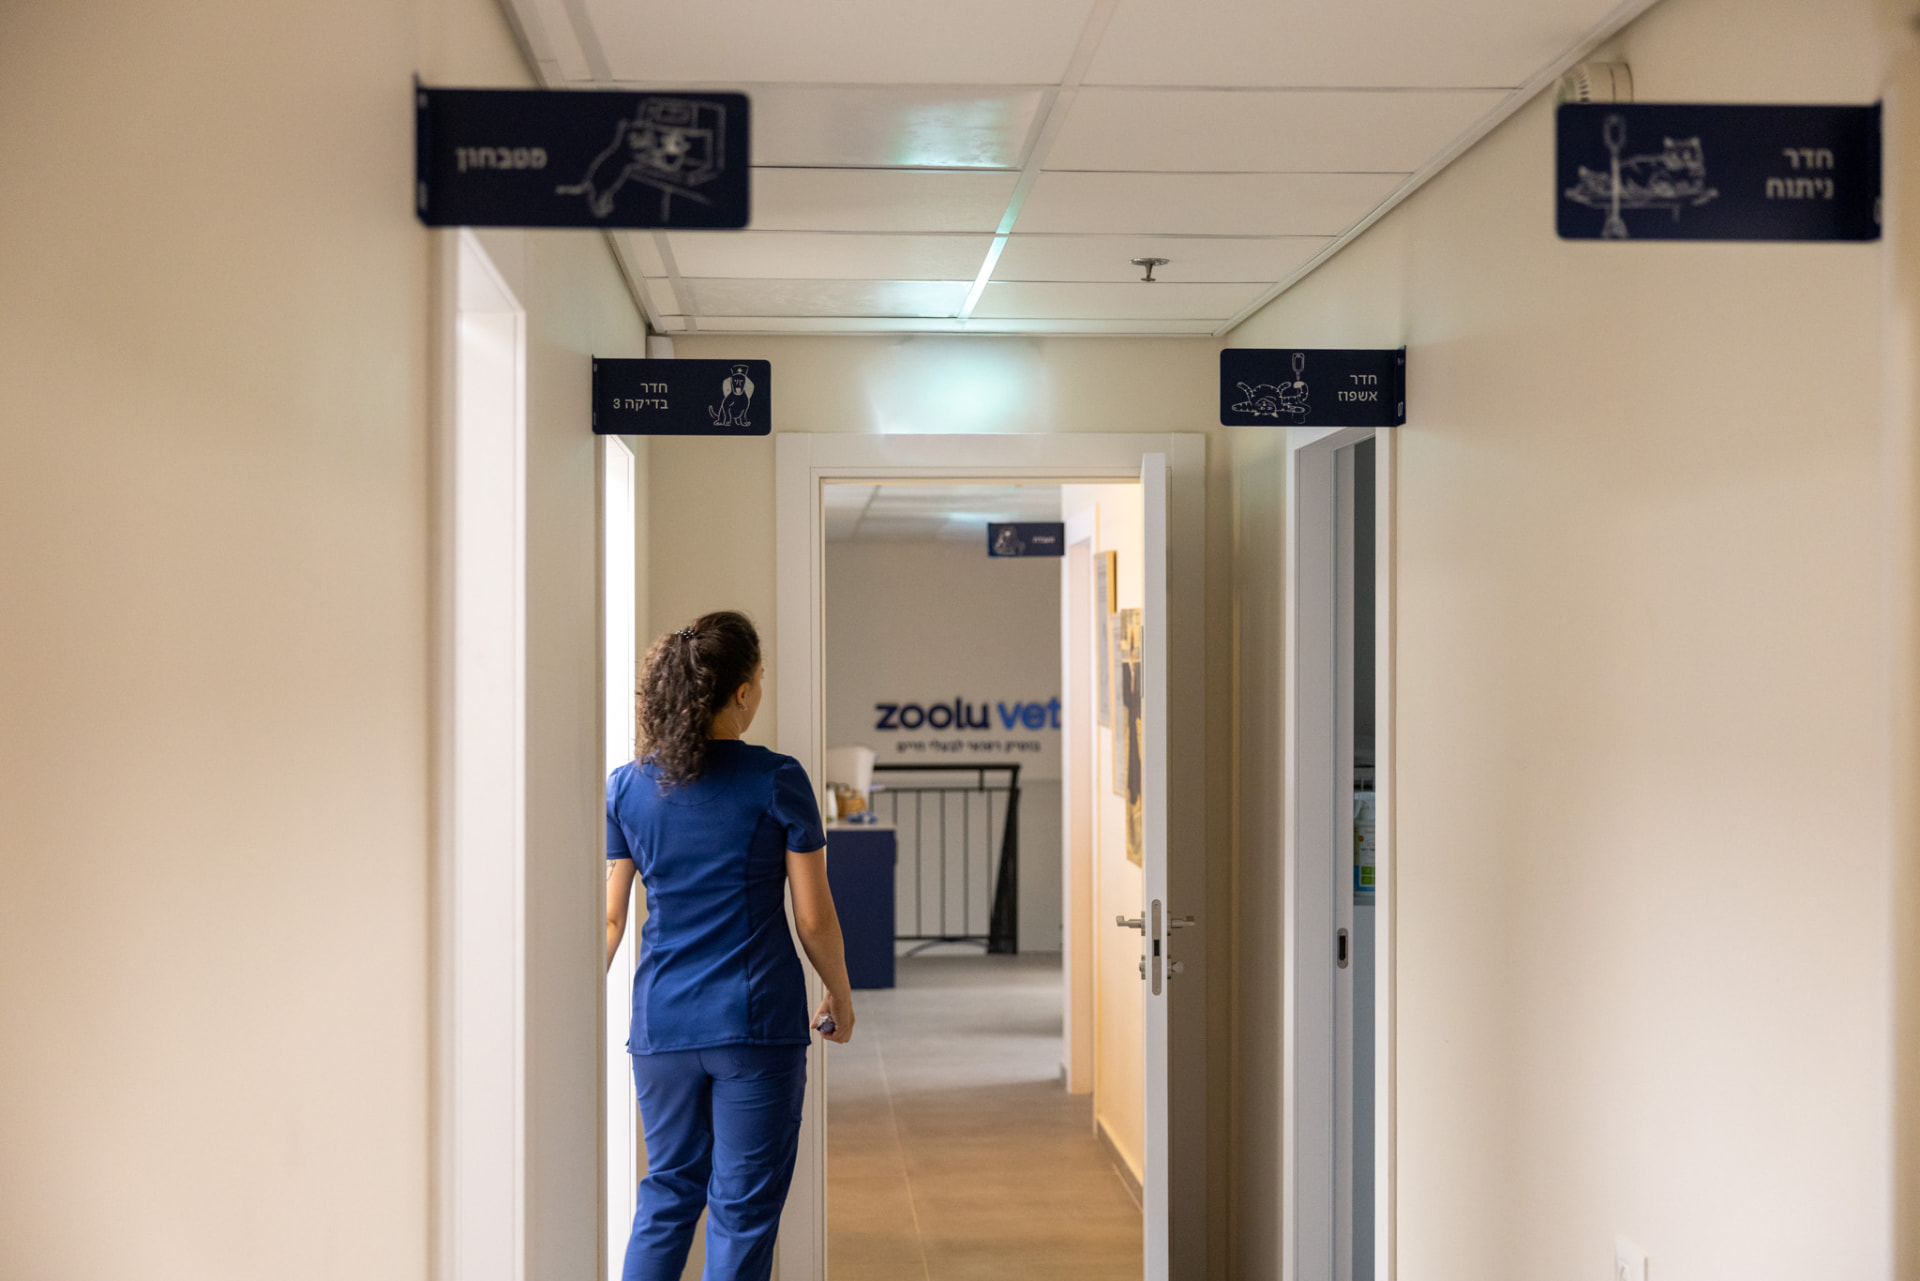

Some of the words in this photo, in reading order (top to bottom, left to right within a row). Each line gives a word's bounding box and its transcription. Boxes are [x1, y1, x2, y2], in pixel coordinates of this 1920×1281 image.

[455, 146, 548, 173] מטבחון
[1783, 147, 1834, 169] חדר
[1765, 177, 1834, 199] ניתוח
[1349, 374, 1378, 385] חדר
[640, 382, 668, 393] חדר
[1337, 390, 1378, 402] אשפוז
[612, 398, 621, 410] 3
[624, 398, 669, 412] בדיקה
[875, 697, 990, 730] zoolu
[997, 697, 1061, 730] vet
